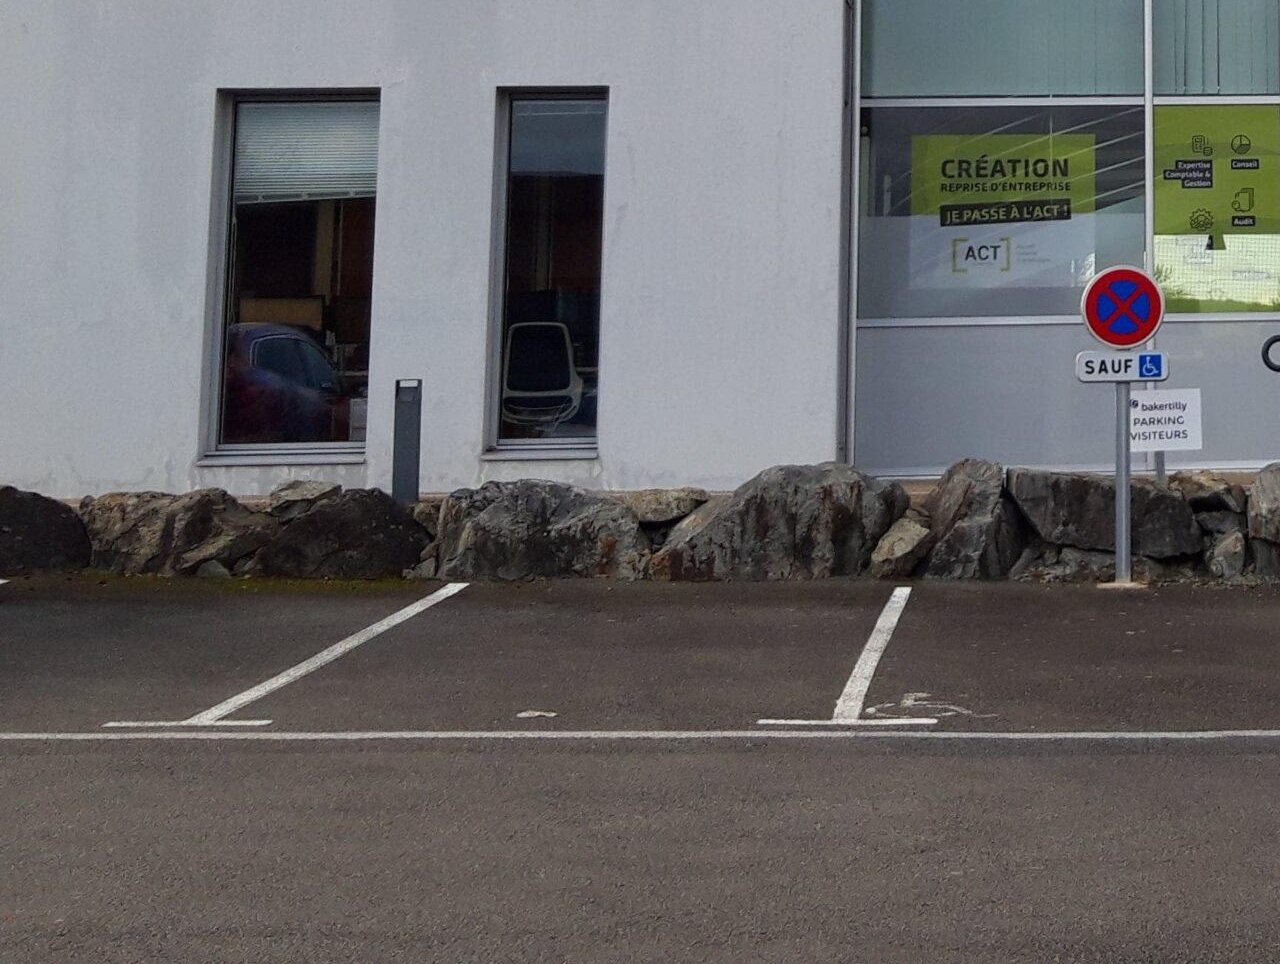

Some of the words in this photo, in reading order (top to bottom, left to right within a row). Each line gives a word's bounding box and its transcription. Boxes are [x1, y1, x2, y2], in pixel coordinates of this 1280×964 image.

[941, 154, 1069, 178] CRÉATION
[1178, 161, 1211, 169] Expertise
[1232, 160, 1258, 168] Conseil
[1165, 170, 1202, 179] Comptable
[941, 182, 988, 192] REPRISE
[990, 181, 1071, 192] D'ENTREPRISE
[946, 210, 960, 224] JE
[963, 207, 1008, 222] PASSE
[1010, 204, 1020, 219] À
[1023, 205, 1060, 219] L'ACT
[1233, 218, 1254, 226] Audit
[965, 245, 1001, 261] ACT
[1084, 358, 1134, 375] SAUF
[1141, 400, 1188, 412] bakertilly
[1133, 415, 1185, 427] PARKING
[1130, 429, 1189, 441] VISITEURS
